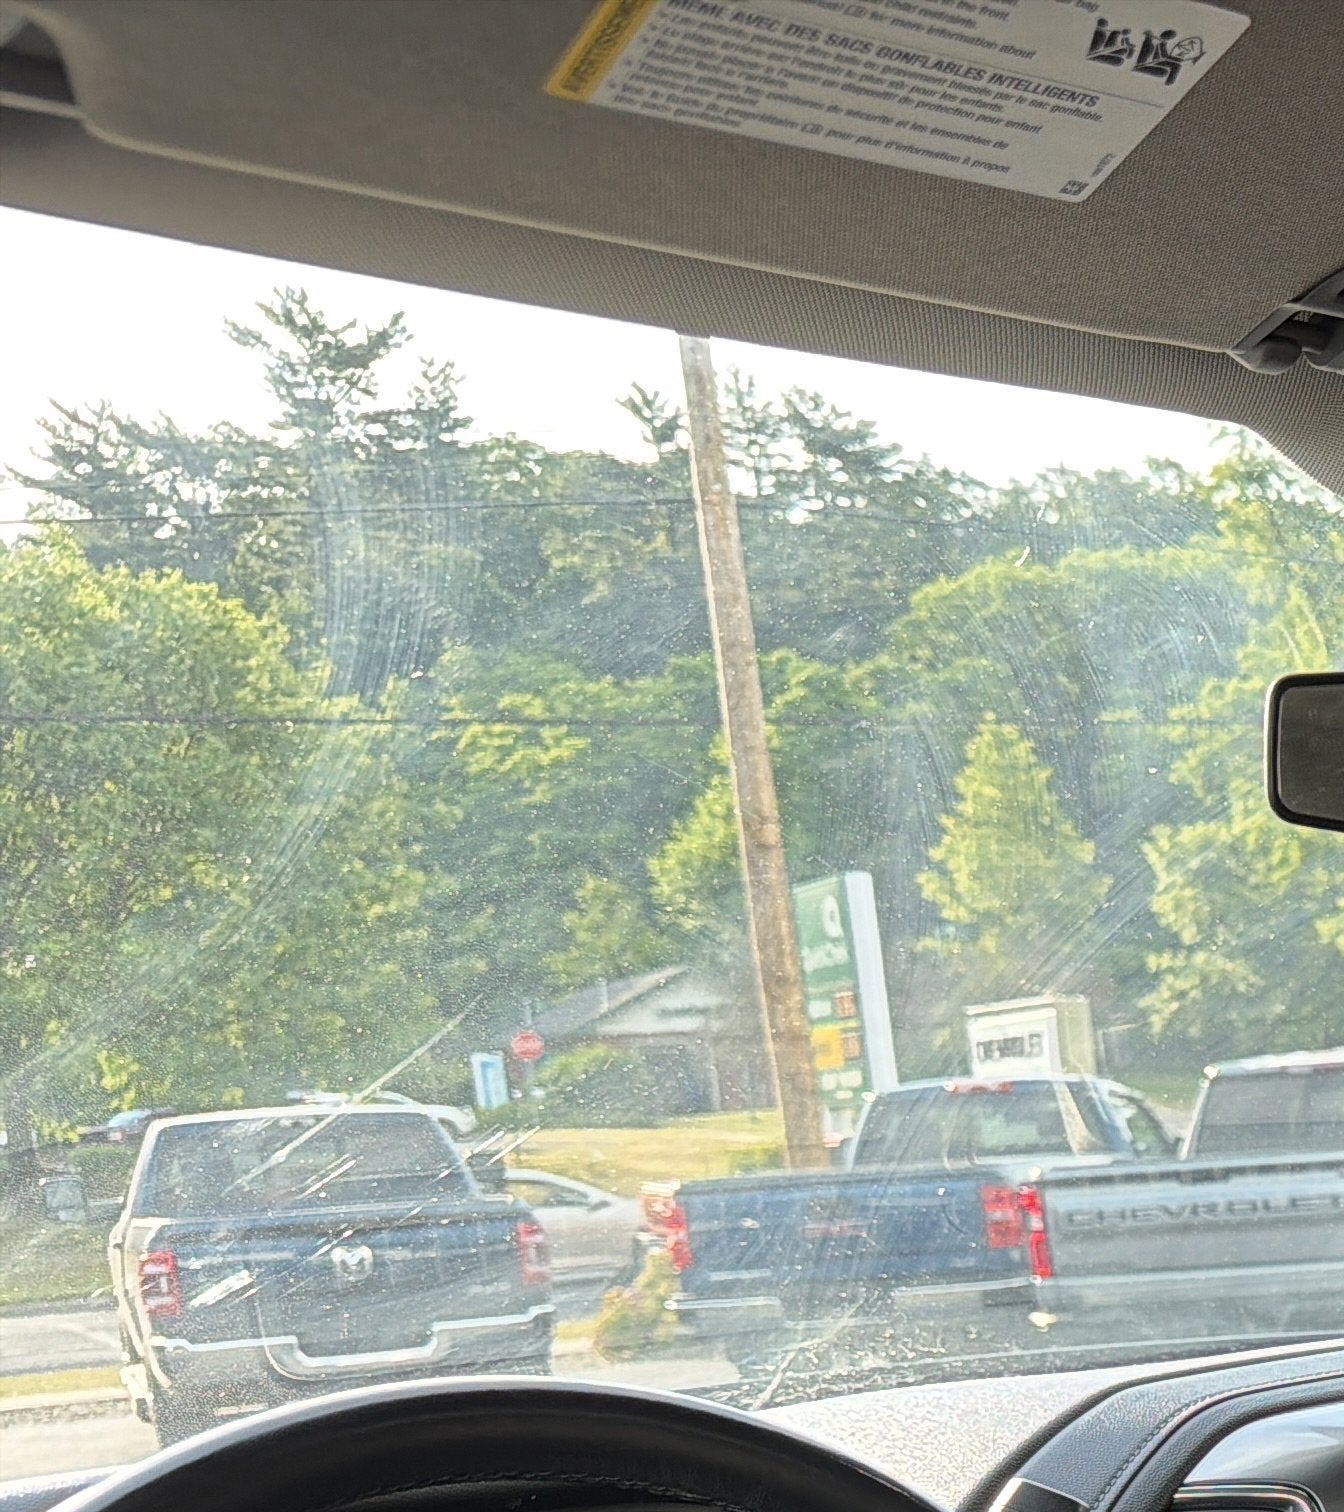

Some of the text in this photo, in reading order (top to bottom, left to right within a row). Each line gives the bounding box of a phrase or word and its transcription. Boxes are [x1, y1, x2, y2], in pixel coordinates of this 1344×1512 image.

[925, 25, 998, 49] information
[999, 44, 1036, 60] about
[784, 23, 821, 43] DES
[823, 32, 875, 54] SACS
[876, 45, 987, 80] GONFLABLES
[987, 73, 1100, 107] INTELLIGENTS
[914, 100, 975, 121] protection
[1004, 119, 1043, 135] enfant
[970, 157, 1011, 175] propos
